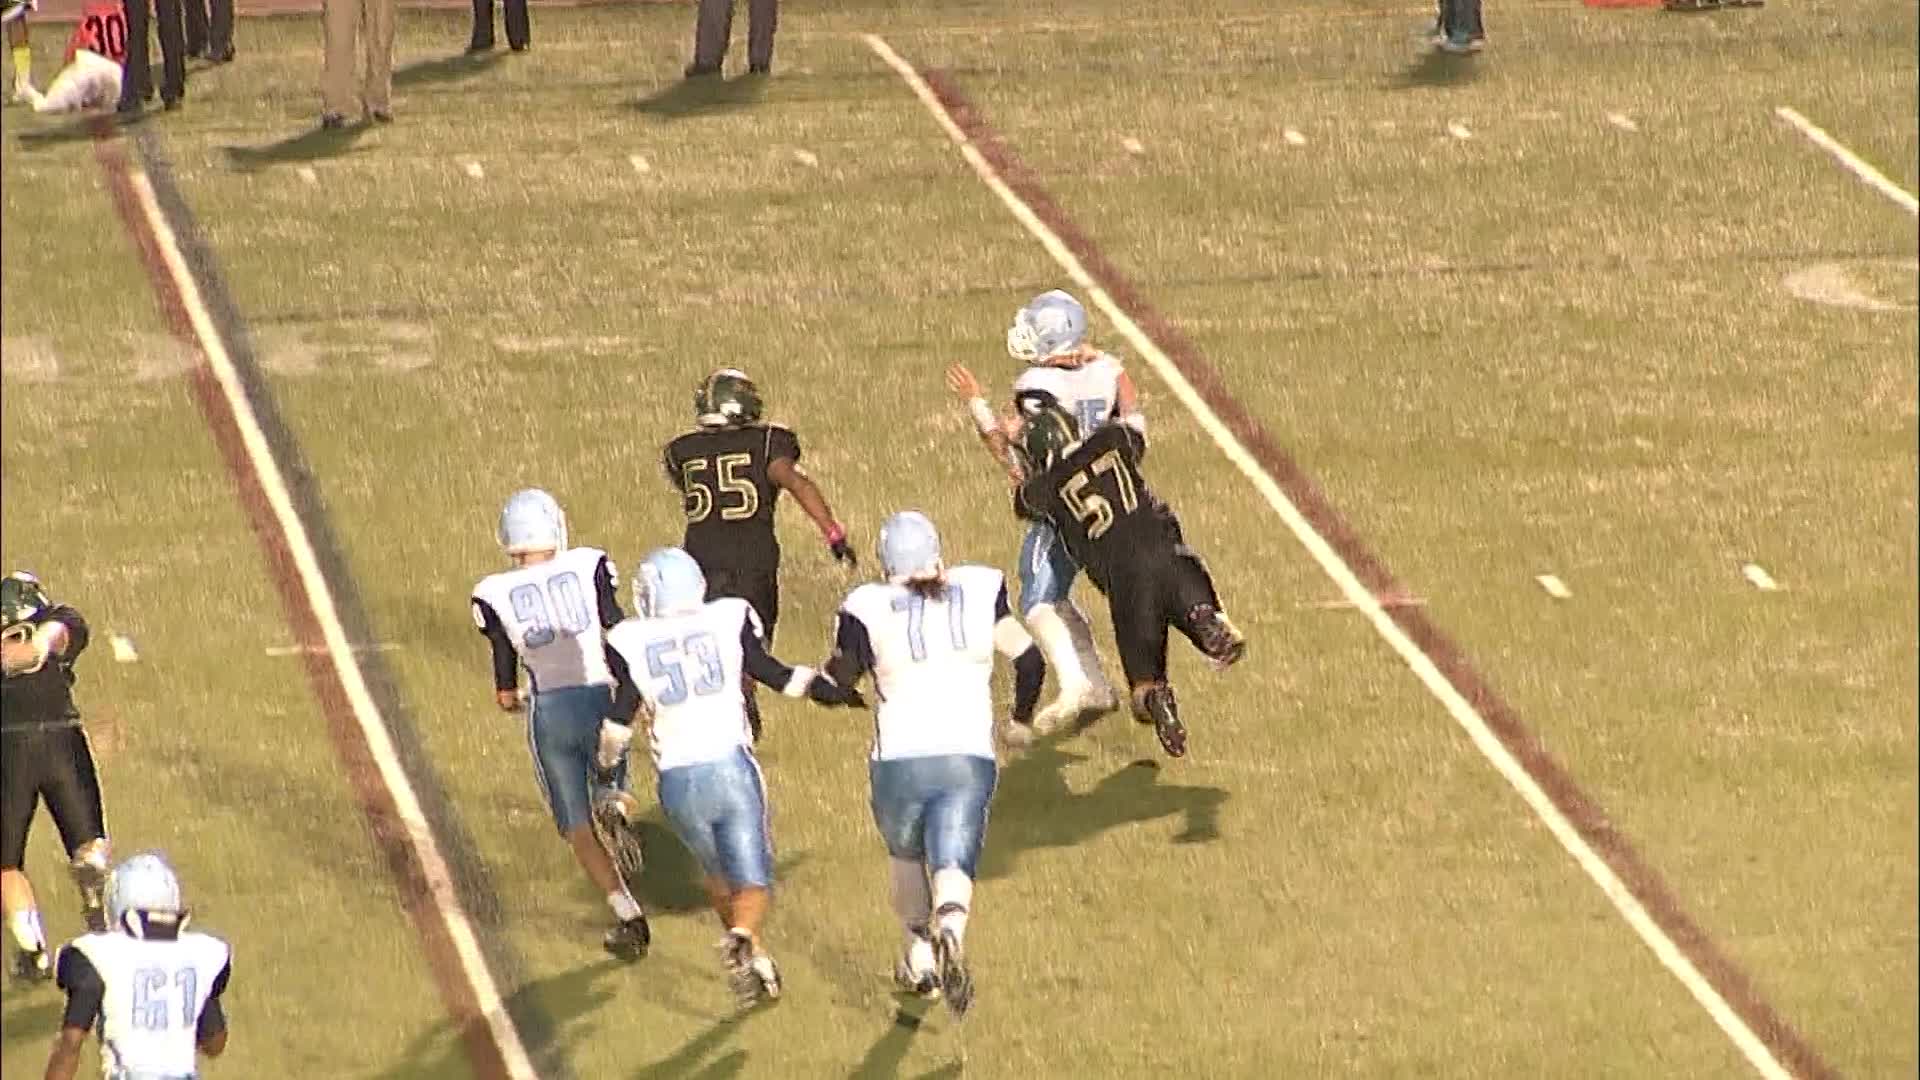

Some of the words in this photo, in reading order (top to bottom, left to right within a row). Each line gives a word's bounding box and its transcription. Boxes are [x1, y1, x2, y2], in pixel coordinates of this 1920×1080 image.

[85, 15, 125, 61] 30
[683, 453, 758, 523] 55
[1058, 450, 1138, 540] 57
[509, 571, 590, 648] 90
[646, 633, 725, 706] 53
[131, 966, 198, 1031] 61
